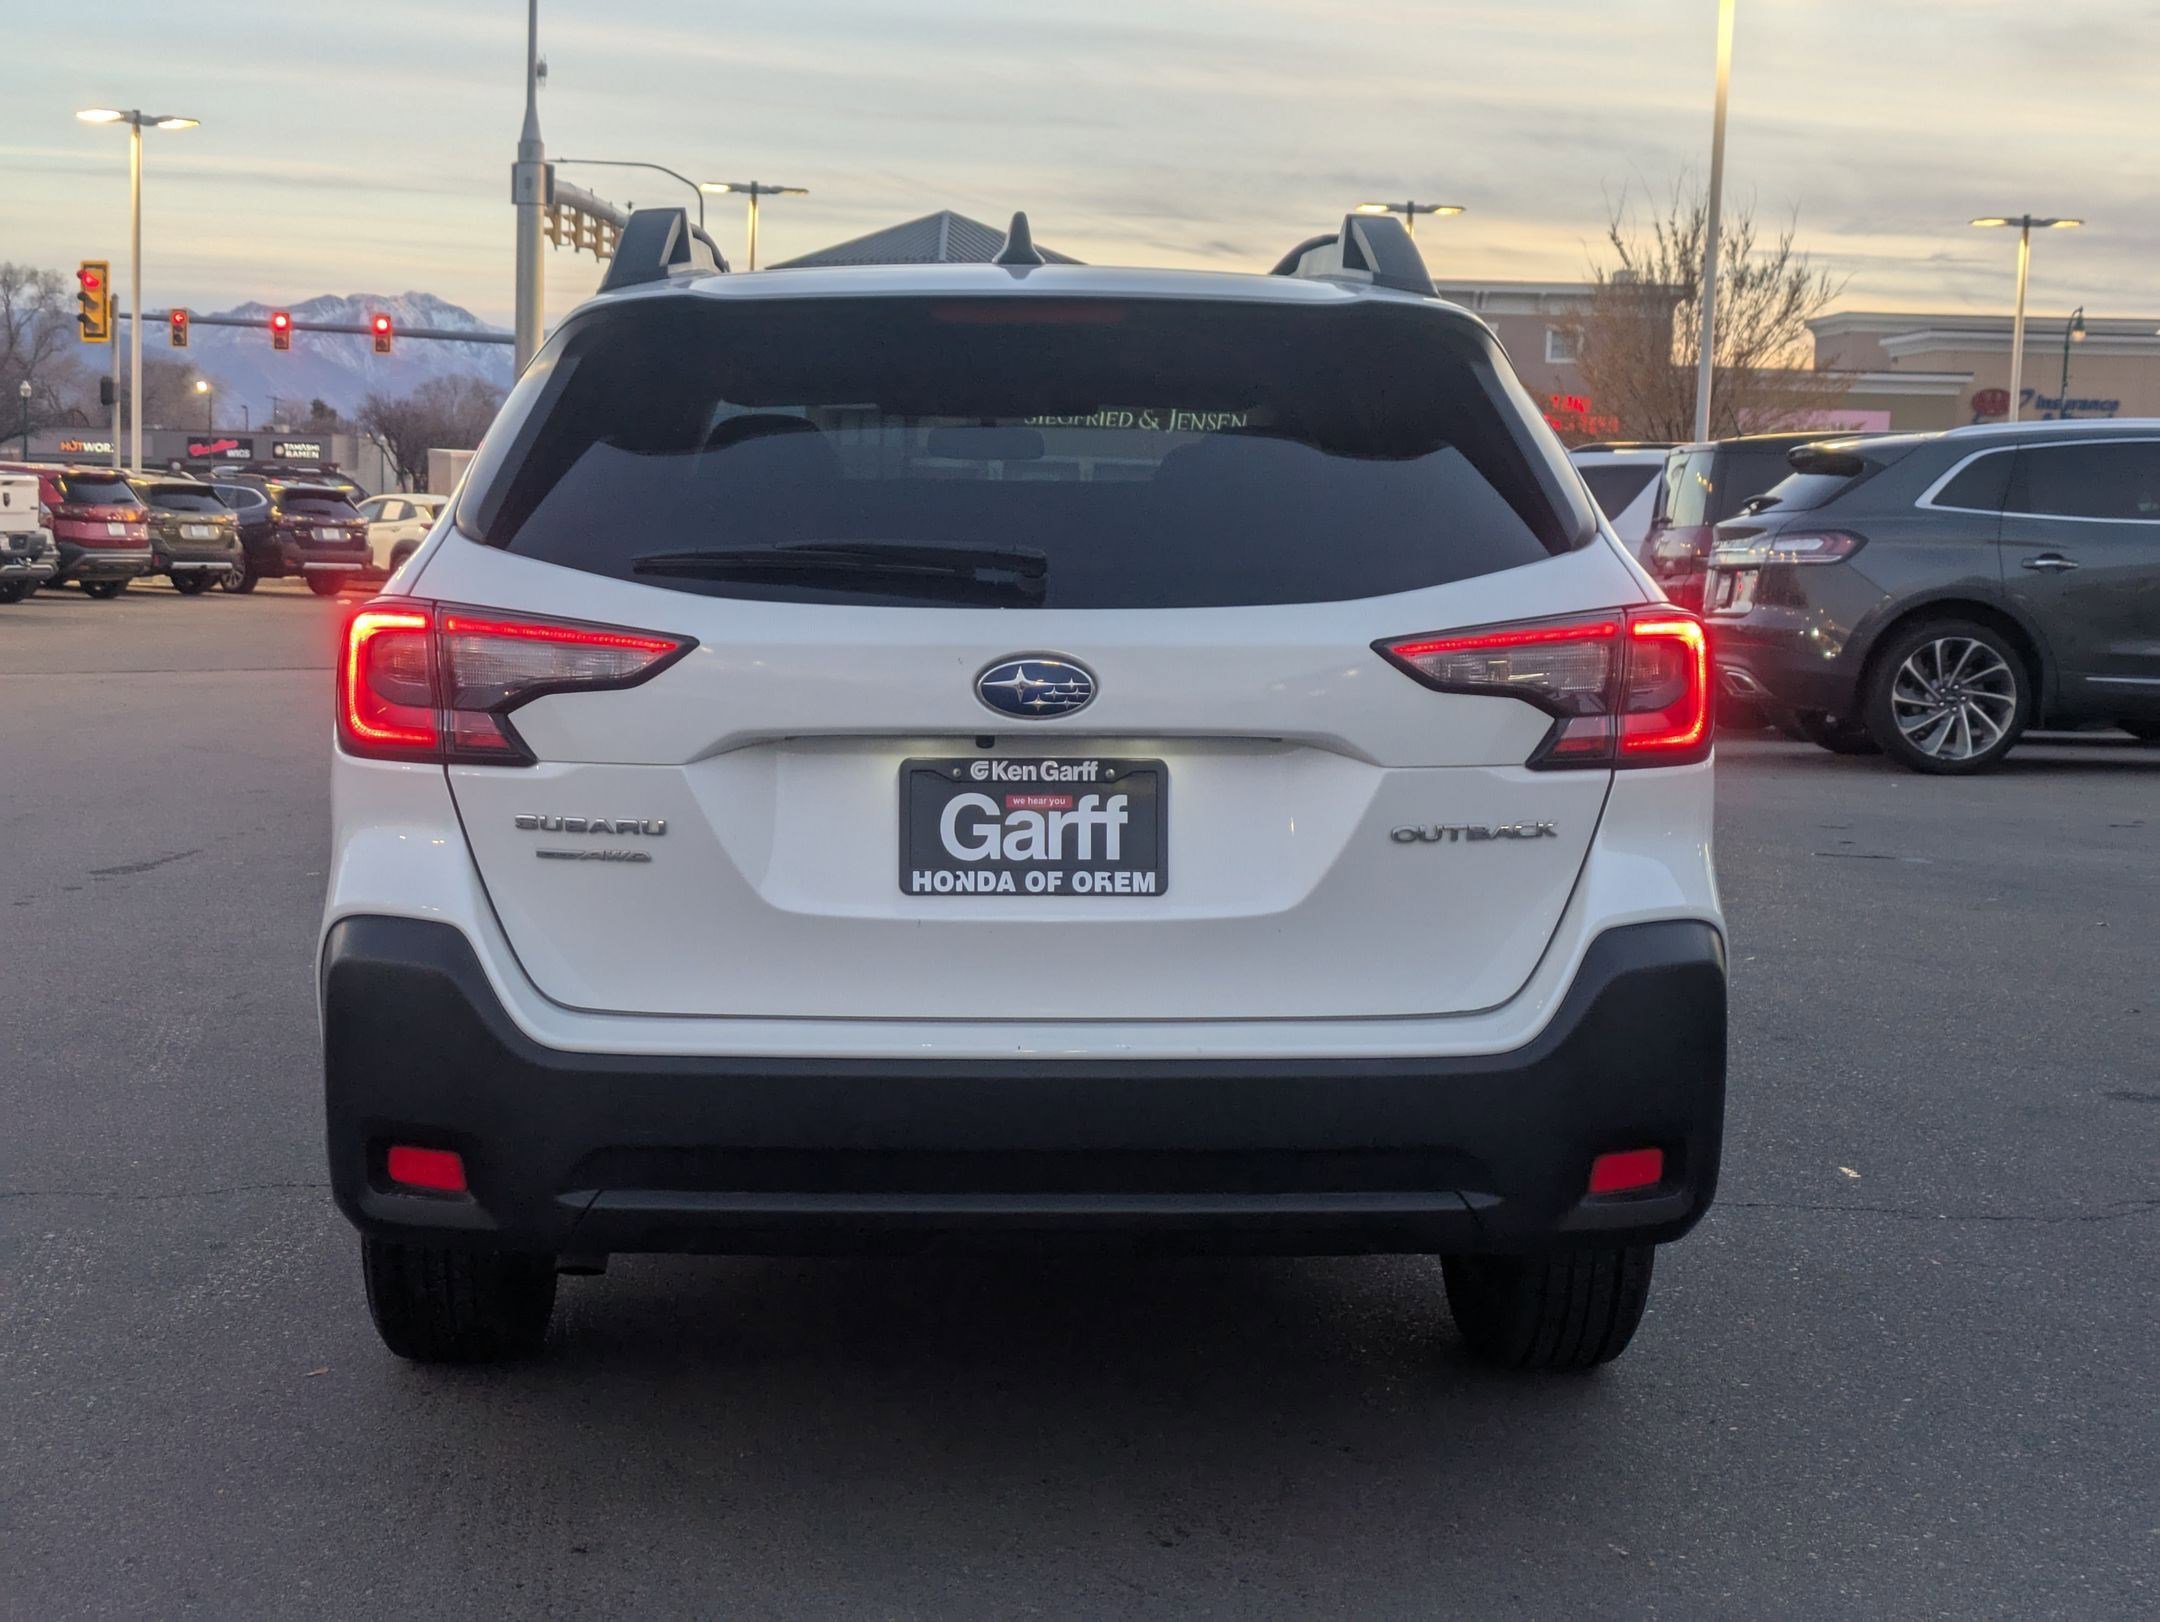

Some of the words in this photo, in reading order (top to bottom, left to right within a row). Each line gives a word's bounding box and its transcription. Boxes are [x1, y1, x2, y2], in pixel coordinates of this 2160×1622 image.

[1139, 409, 1160, 430] &
[1166, 408, 1248, 433] JENSEN
[60, 440, 115, 453] HOTWOR
[226, 448, 251, 458] WIGS
[285, 450, 320, 459] RAMEN
[992, 762, 1037, 781] Ken
[1041, 760, 1099, 781] Garff
[1013, 797, 1026, 805] we
[1027, 795, 1048, 805] hear
[1048, 797, 1066, 808] you
[513, 813, 668, 836] SUBARU
[939, 792, 1129, 861] Garff
[1390, 820, 1558, 844] OUTBACK
[912, 870, 1017, 893] HONDA
[1024, 870, 1063, 893] OF
[1072, 870, 1156, 893] OREM
